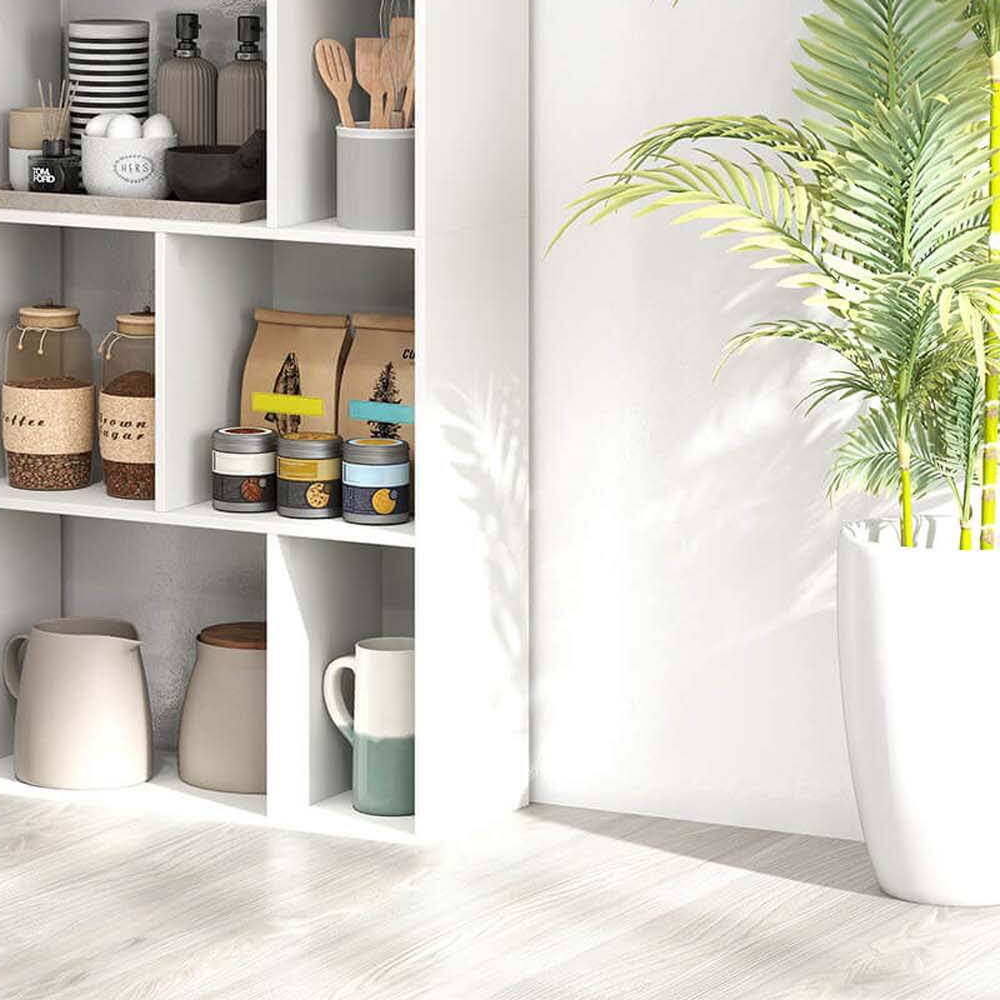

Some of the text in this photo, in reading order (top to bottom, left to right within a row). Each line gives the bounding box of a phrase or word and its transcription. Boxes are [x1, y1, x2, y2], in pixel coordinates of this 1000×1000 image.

[32, 167, 50, 176] TOM
[121, 161, 150, 174] HERS
[100, 427, 146, 441] ugar
